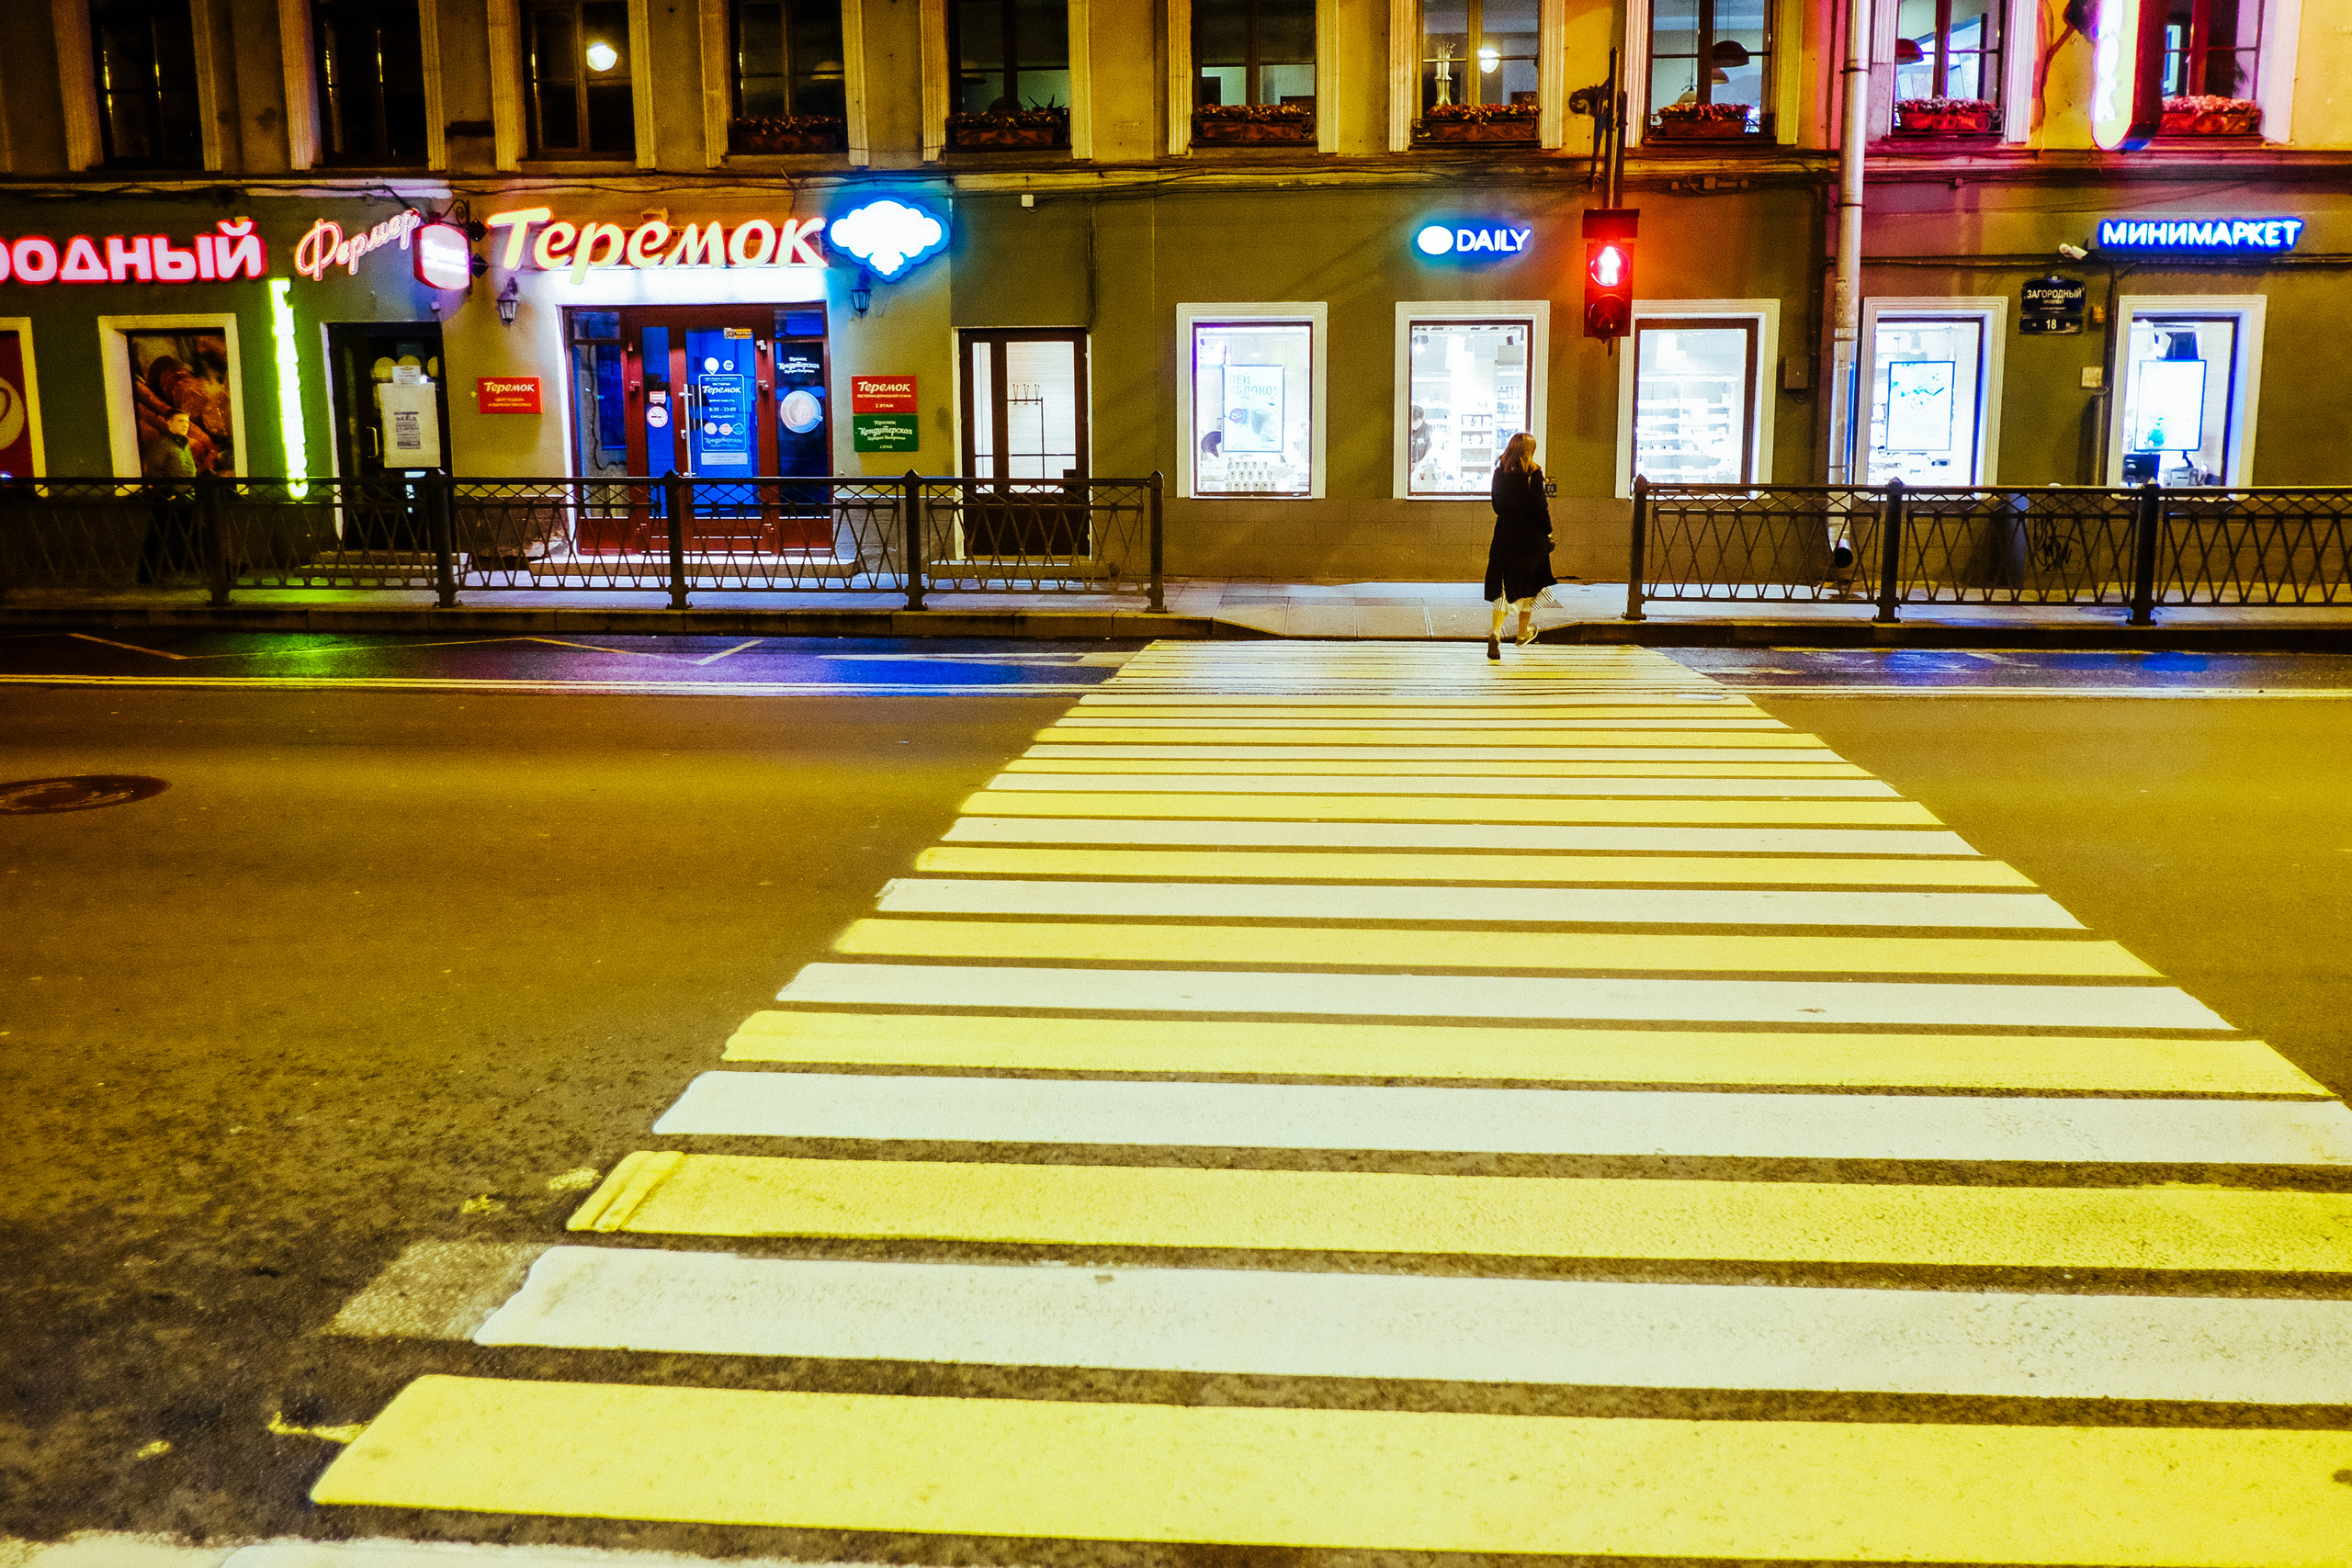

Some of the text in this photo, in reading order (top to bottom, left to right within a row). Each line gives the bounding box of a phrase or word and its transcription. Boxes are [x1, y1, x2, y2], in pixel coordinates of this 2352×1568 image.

[2103, 220, 2302, 246] МИНИМАРКЕТ
[294, 208, 421, 281] Фермер
[486, 207, 829, 286] Теремок
[1456, 228, 1532, 252] DAILY
[0, 219, 265, 284] ОДНЫЙ
[2027, 288, 2082, 299] ЗАГОРОДНЫЙ
[2046, 319, 2057, 330] 18
[1228, 372, 1250, 385] ПЕЙ
[483, 381, 535, 394] Теремок
[702, 385, 741, 395] Теремок
[857, 381, 910, 394] Теремок
[858, 425, 913, 437] Кондитерская
